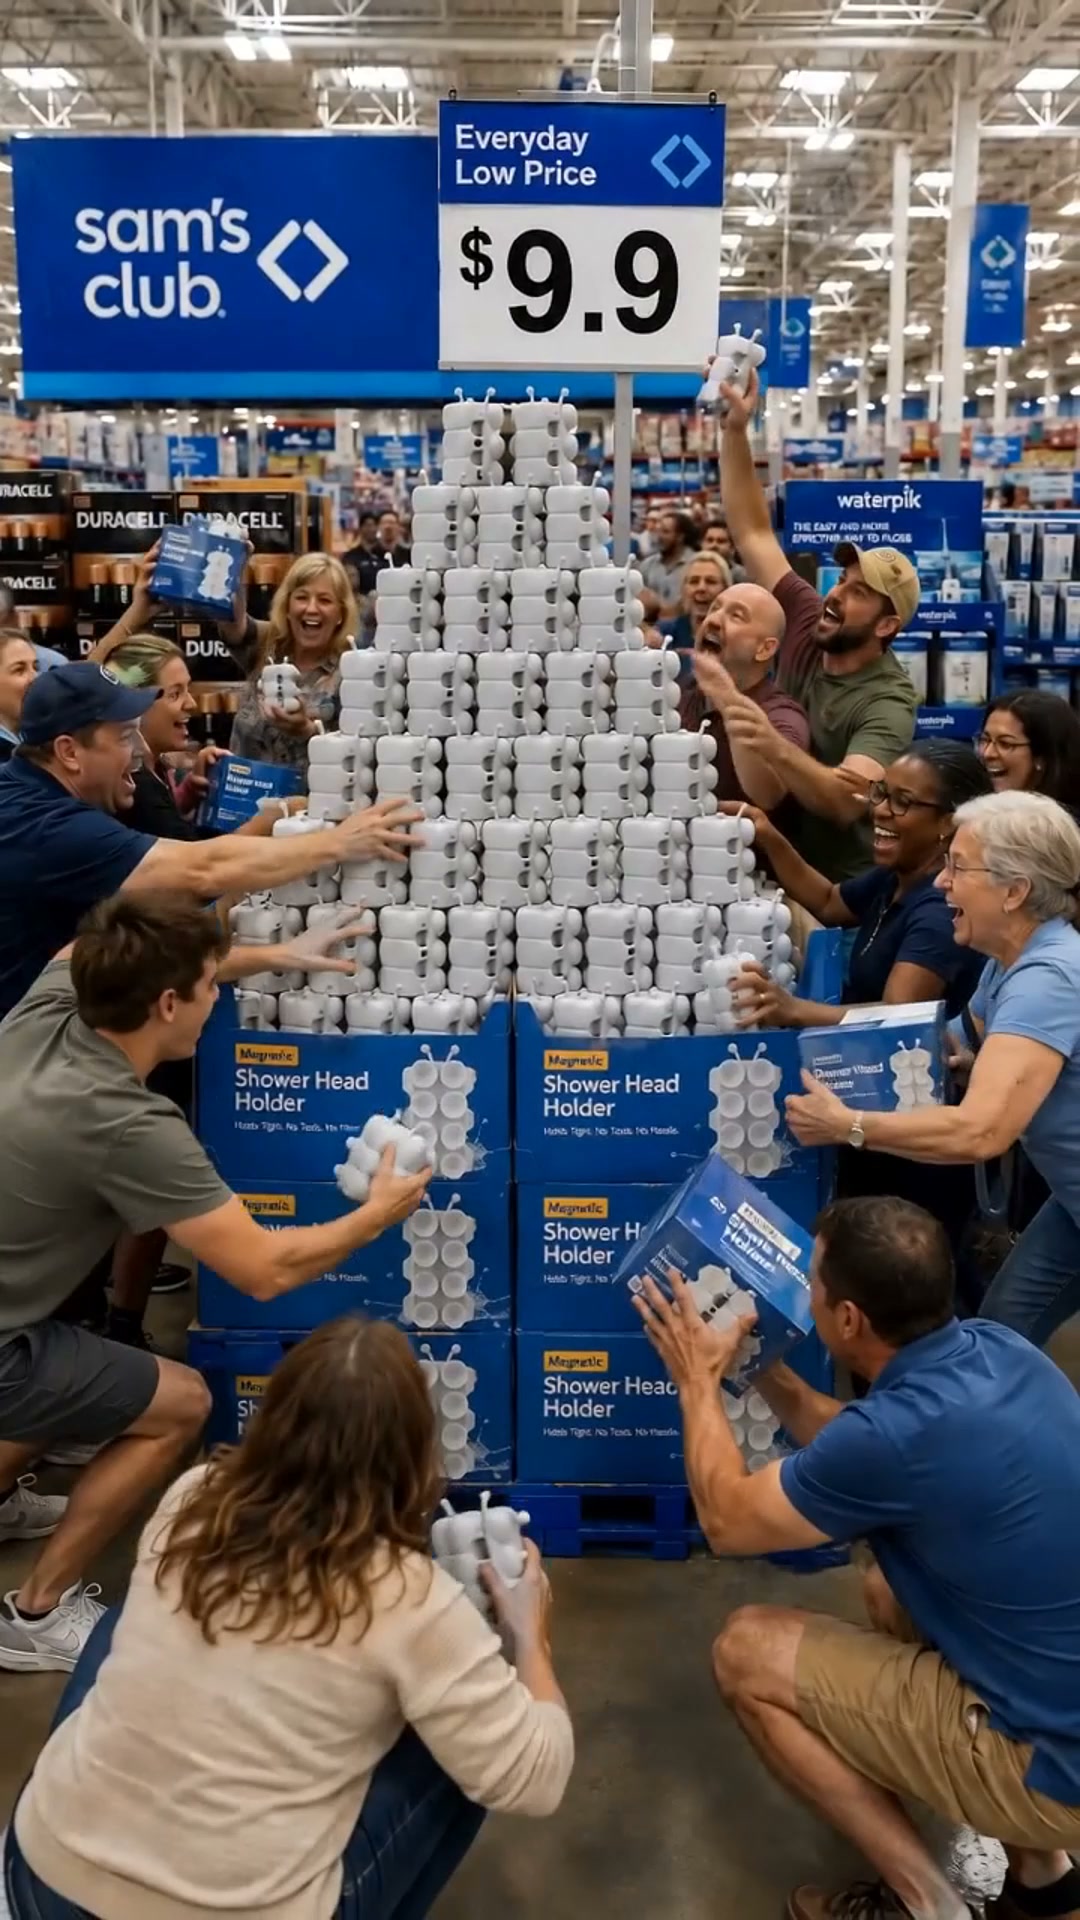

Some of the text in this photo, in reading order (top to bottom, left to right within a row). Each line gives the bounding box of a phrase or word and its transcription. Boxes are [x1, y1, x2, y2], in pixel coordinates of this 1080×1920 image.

[456, 124, 589, 156] Everyday
[456, 159, 597, 186] Low Price
[75, 198, 251, 253] sam's
[837, 484, 922, 513] waterpik
[76, 511, 167, 529] DURACELL
[548, 1055, 604, 1068] Magnetic
[235, 1068, 369, 1090] Shower Head
[543, 1073, 680, 1094] Shower Head
[235, 1091, 306, 1112] Holder
[543, 1098, 615, 1117] Holder
[548, 1202, 604, 1215] Magnetic
[543, 1222, 620, 1241] Shower
[543, 1245, 615, 1264] Holder
[548, 1356, 604, 1369] Magnetic
[543, 1375, 620, 1395] Shower
[543, 1398, 615, 1418] Holder
